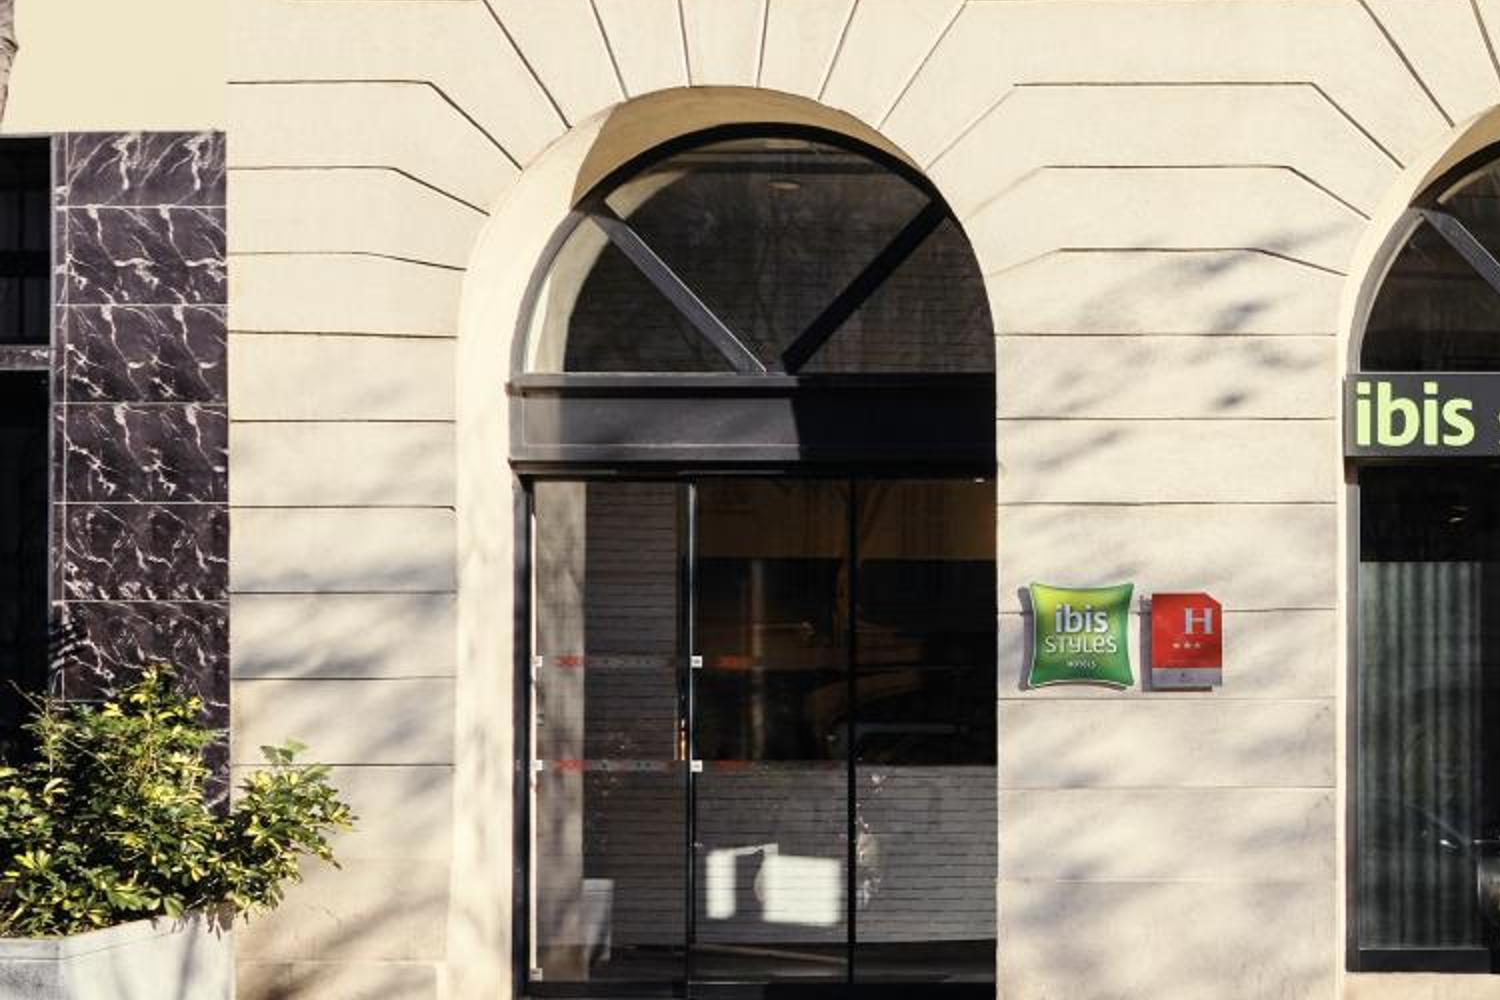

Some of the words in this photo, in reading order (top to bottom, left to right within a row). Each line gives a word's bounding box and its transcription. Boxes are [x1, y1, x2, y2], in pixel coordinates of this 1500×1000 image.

[1356, 382, 1475, 446] ibis
[1055, 603, 1108, 633] ibis
[1184, 607, 1214, 635] H
